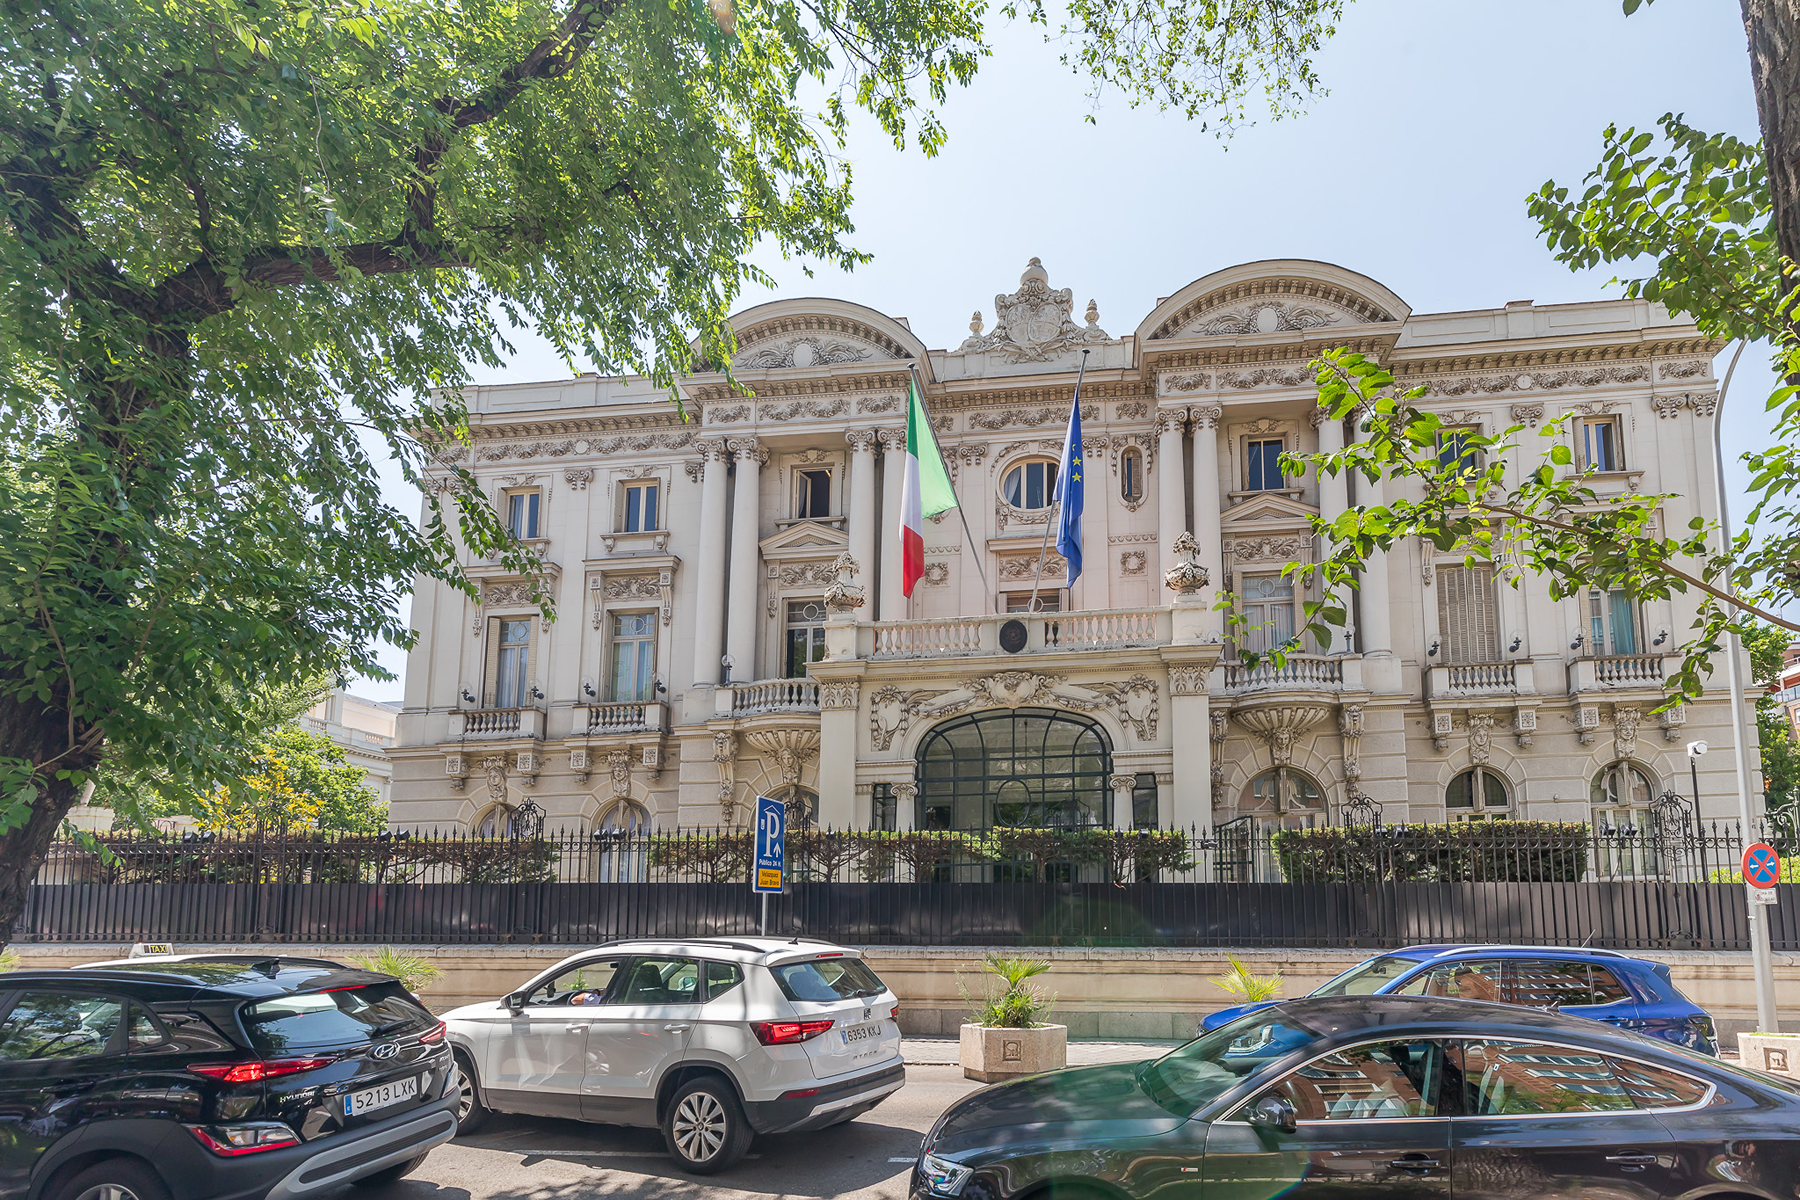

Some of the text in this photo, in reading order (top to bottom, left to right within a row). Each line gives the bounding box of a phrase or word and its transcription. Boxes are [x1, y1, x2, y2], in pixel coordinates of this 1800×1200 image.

[764, 810, 780, 857] P
[150, 945, 167, 953] TAXI
[847, 1028, 867, 1041] 6353
[279, 1090, 315, 1103] HYUNDAI
[356, 1087, 390, 1109] 5213
[394, 1080, 416, 1098] LXK
